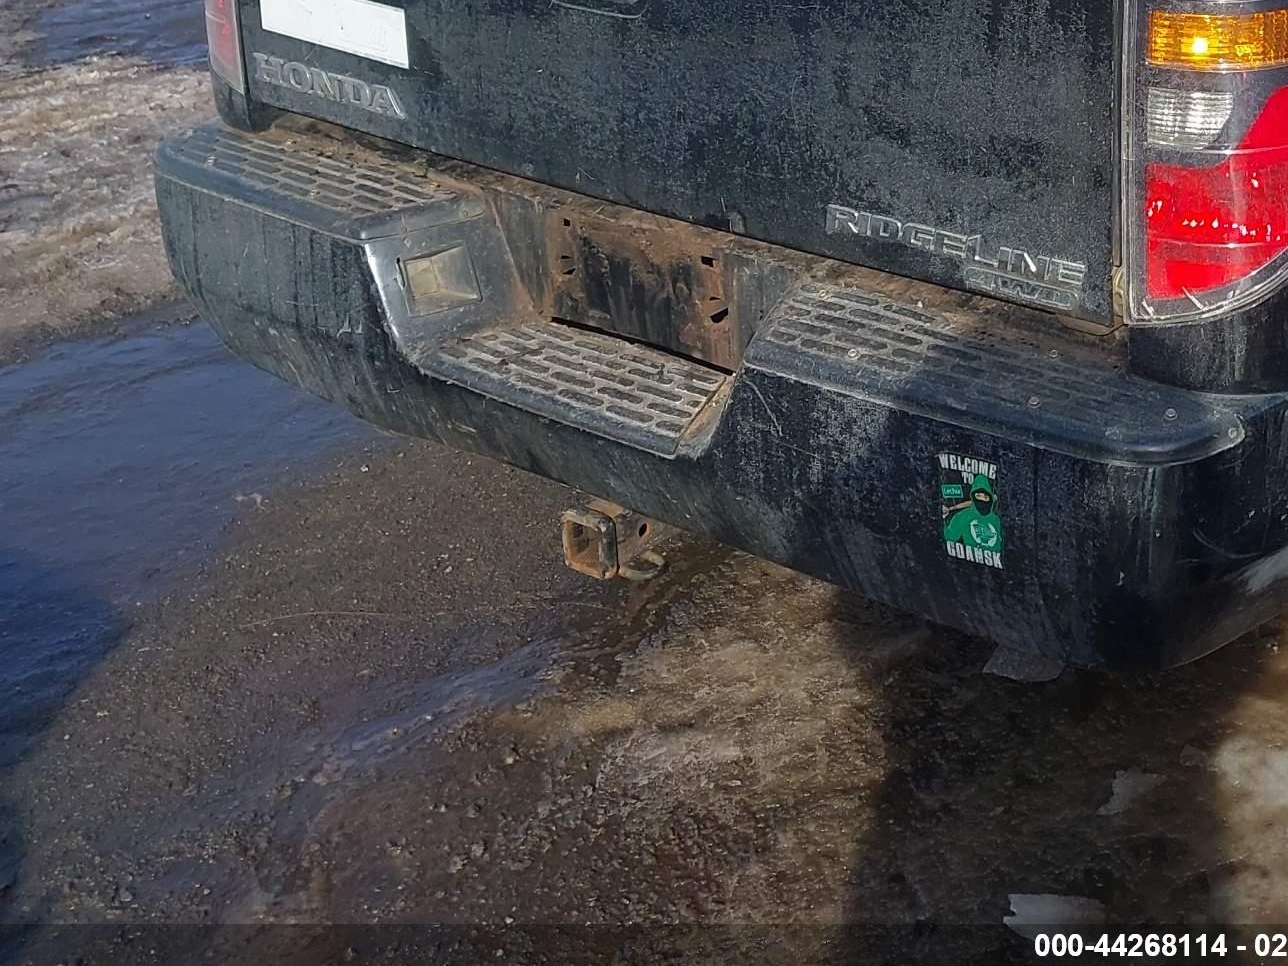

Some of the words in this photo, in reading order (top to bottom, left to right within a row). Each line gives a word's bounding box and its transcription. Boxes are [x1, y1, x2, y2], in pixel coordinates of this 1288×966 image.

[252, 52, 407, 120] HONDA
[825, 203, 1088, 286] RIDGELINE
[967, 269, 1072, 309] 4WD
[939, 453, 998, 480] WELCOME
[961, 472, 974, 485] TO
